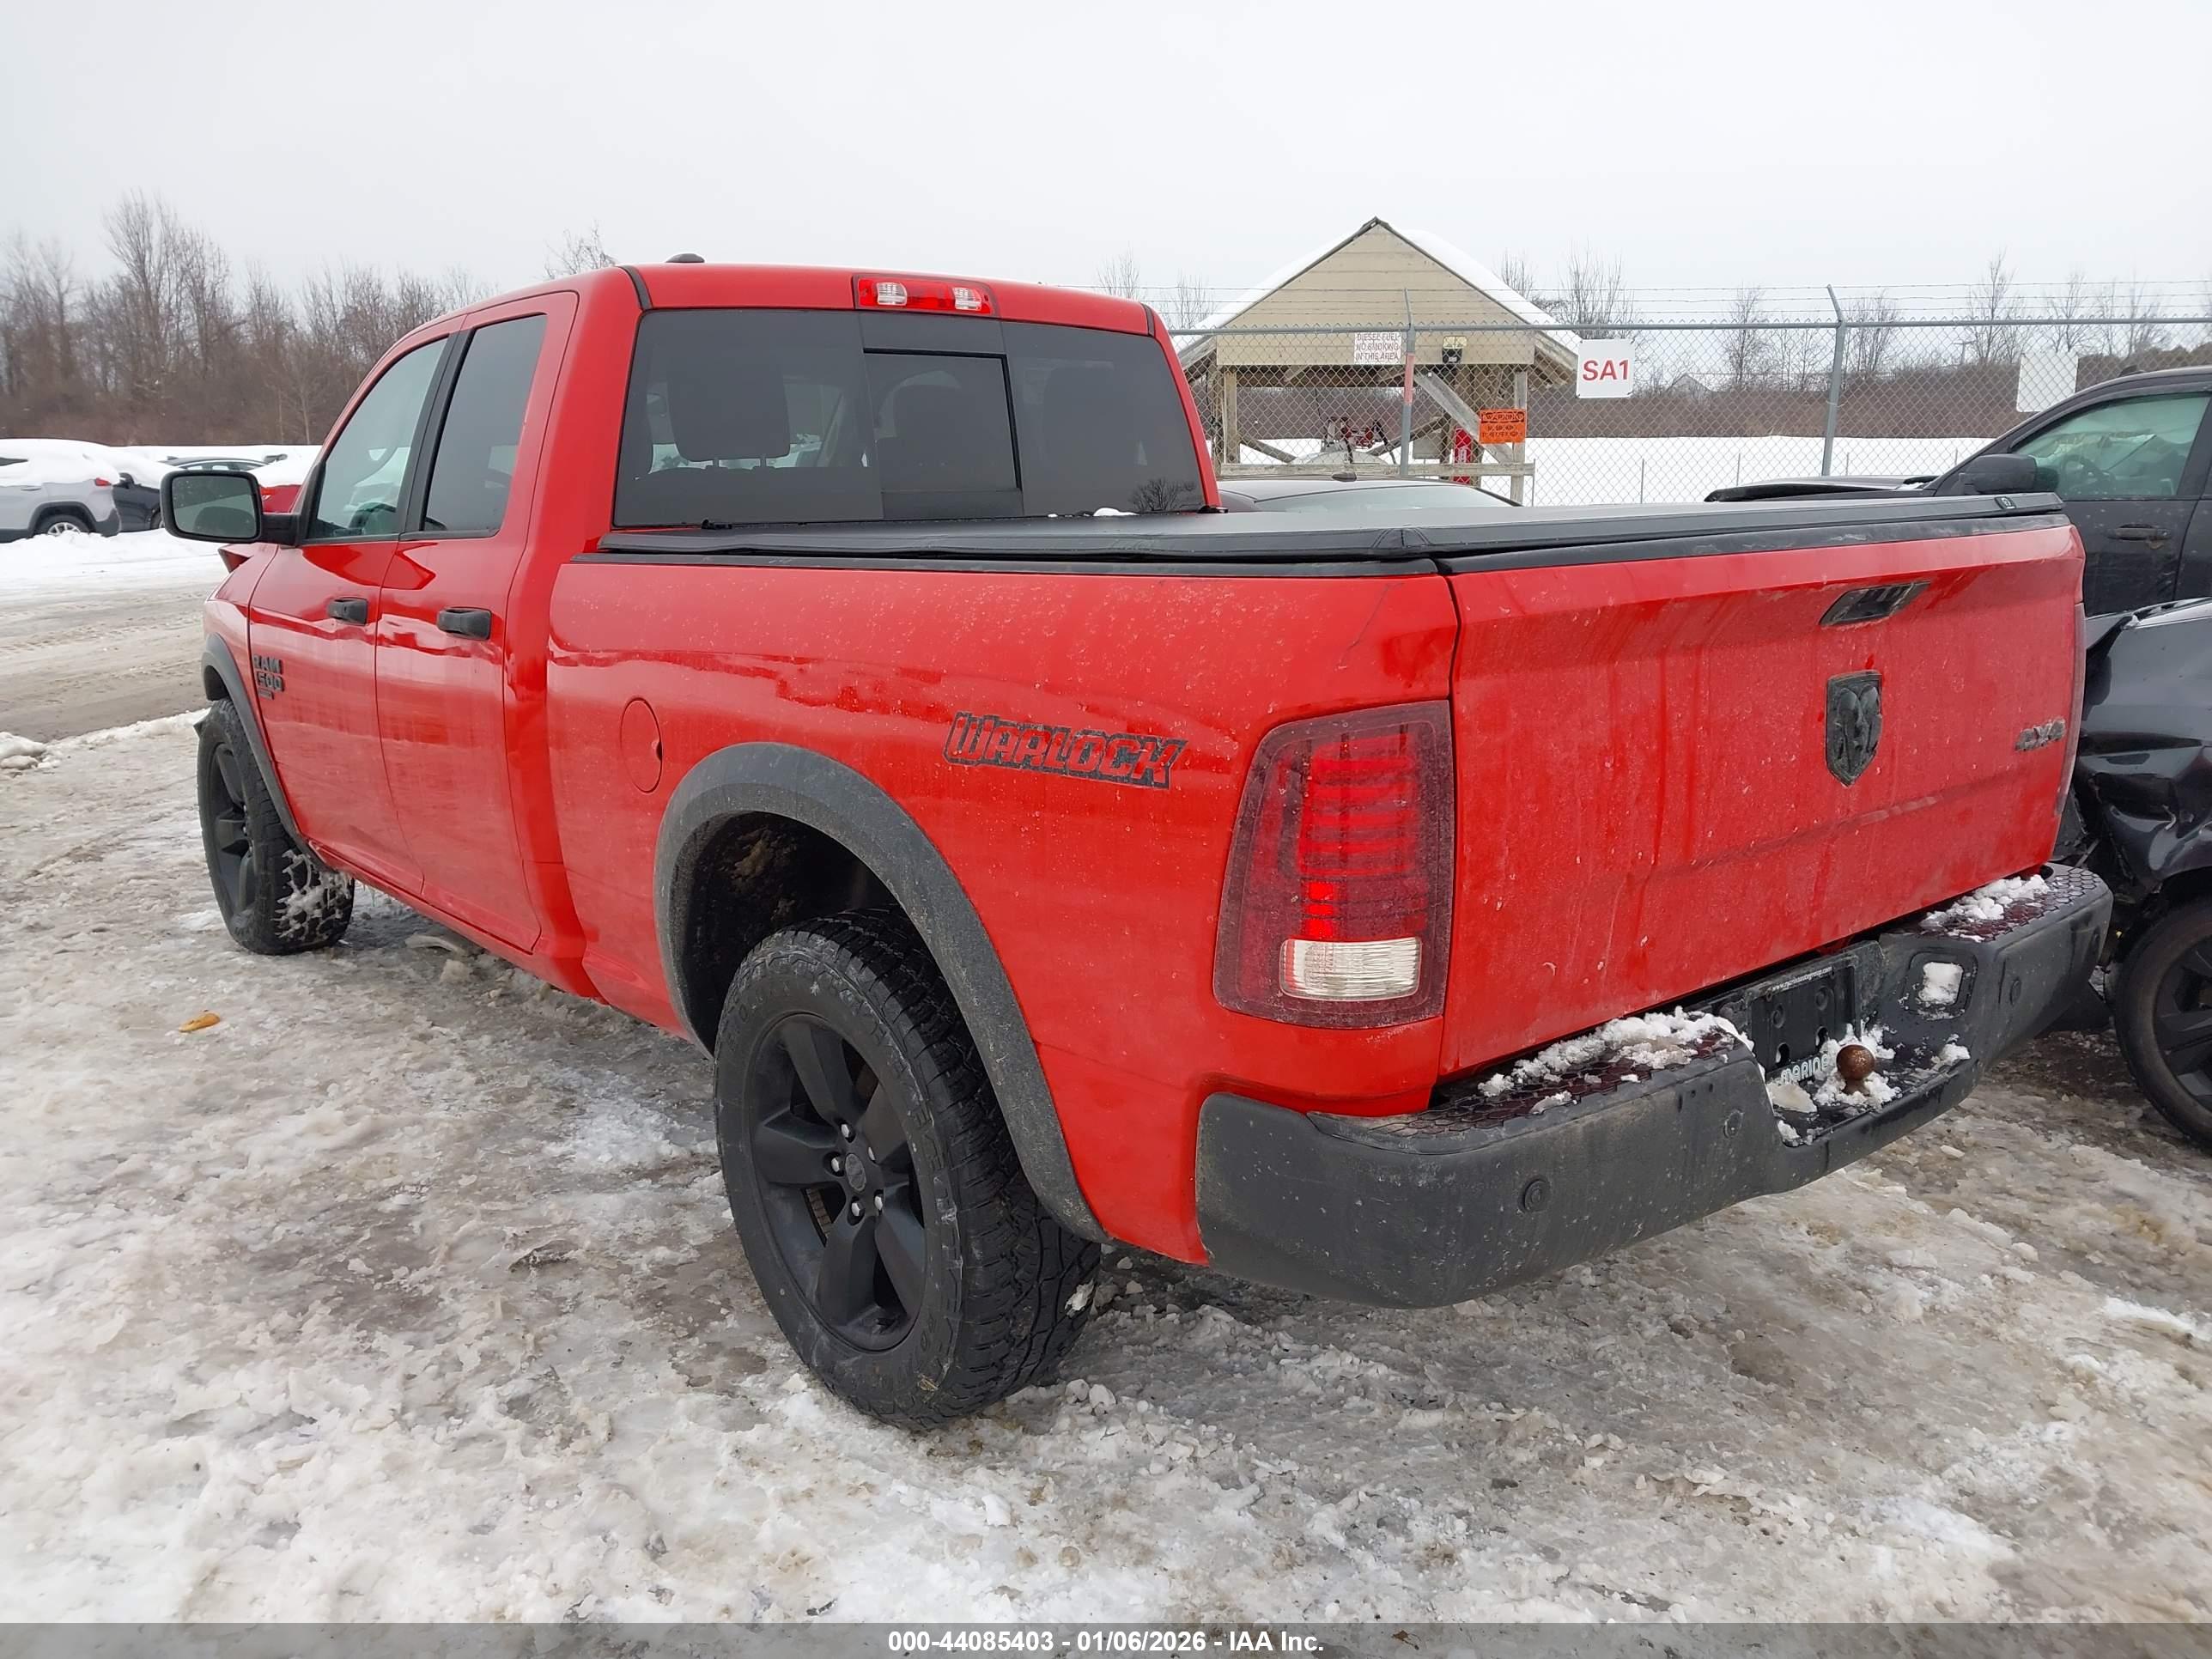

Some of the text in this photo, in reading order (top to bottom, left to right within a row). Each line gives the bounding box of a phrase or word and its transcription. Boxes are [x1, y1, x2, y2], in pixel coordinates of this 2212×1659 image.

[1583, 359, 1629, 380] SA1
[253, 654, 282, 674] RAM
[944, 711, 1188, 790] WARLOCK
